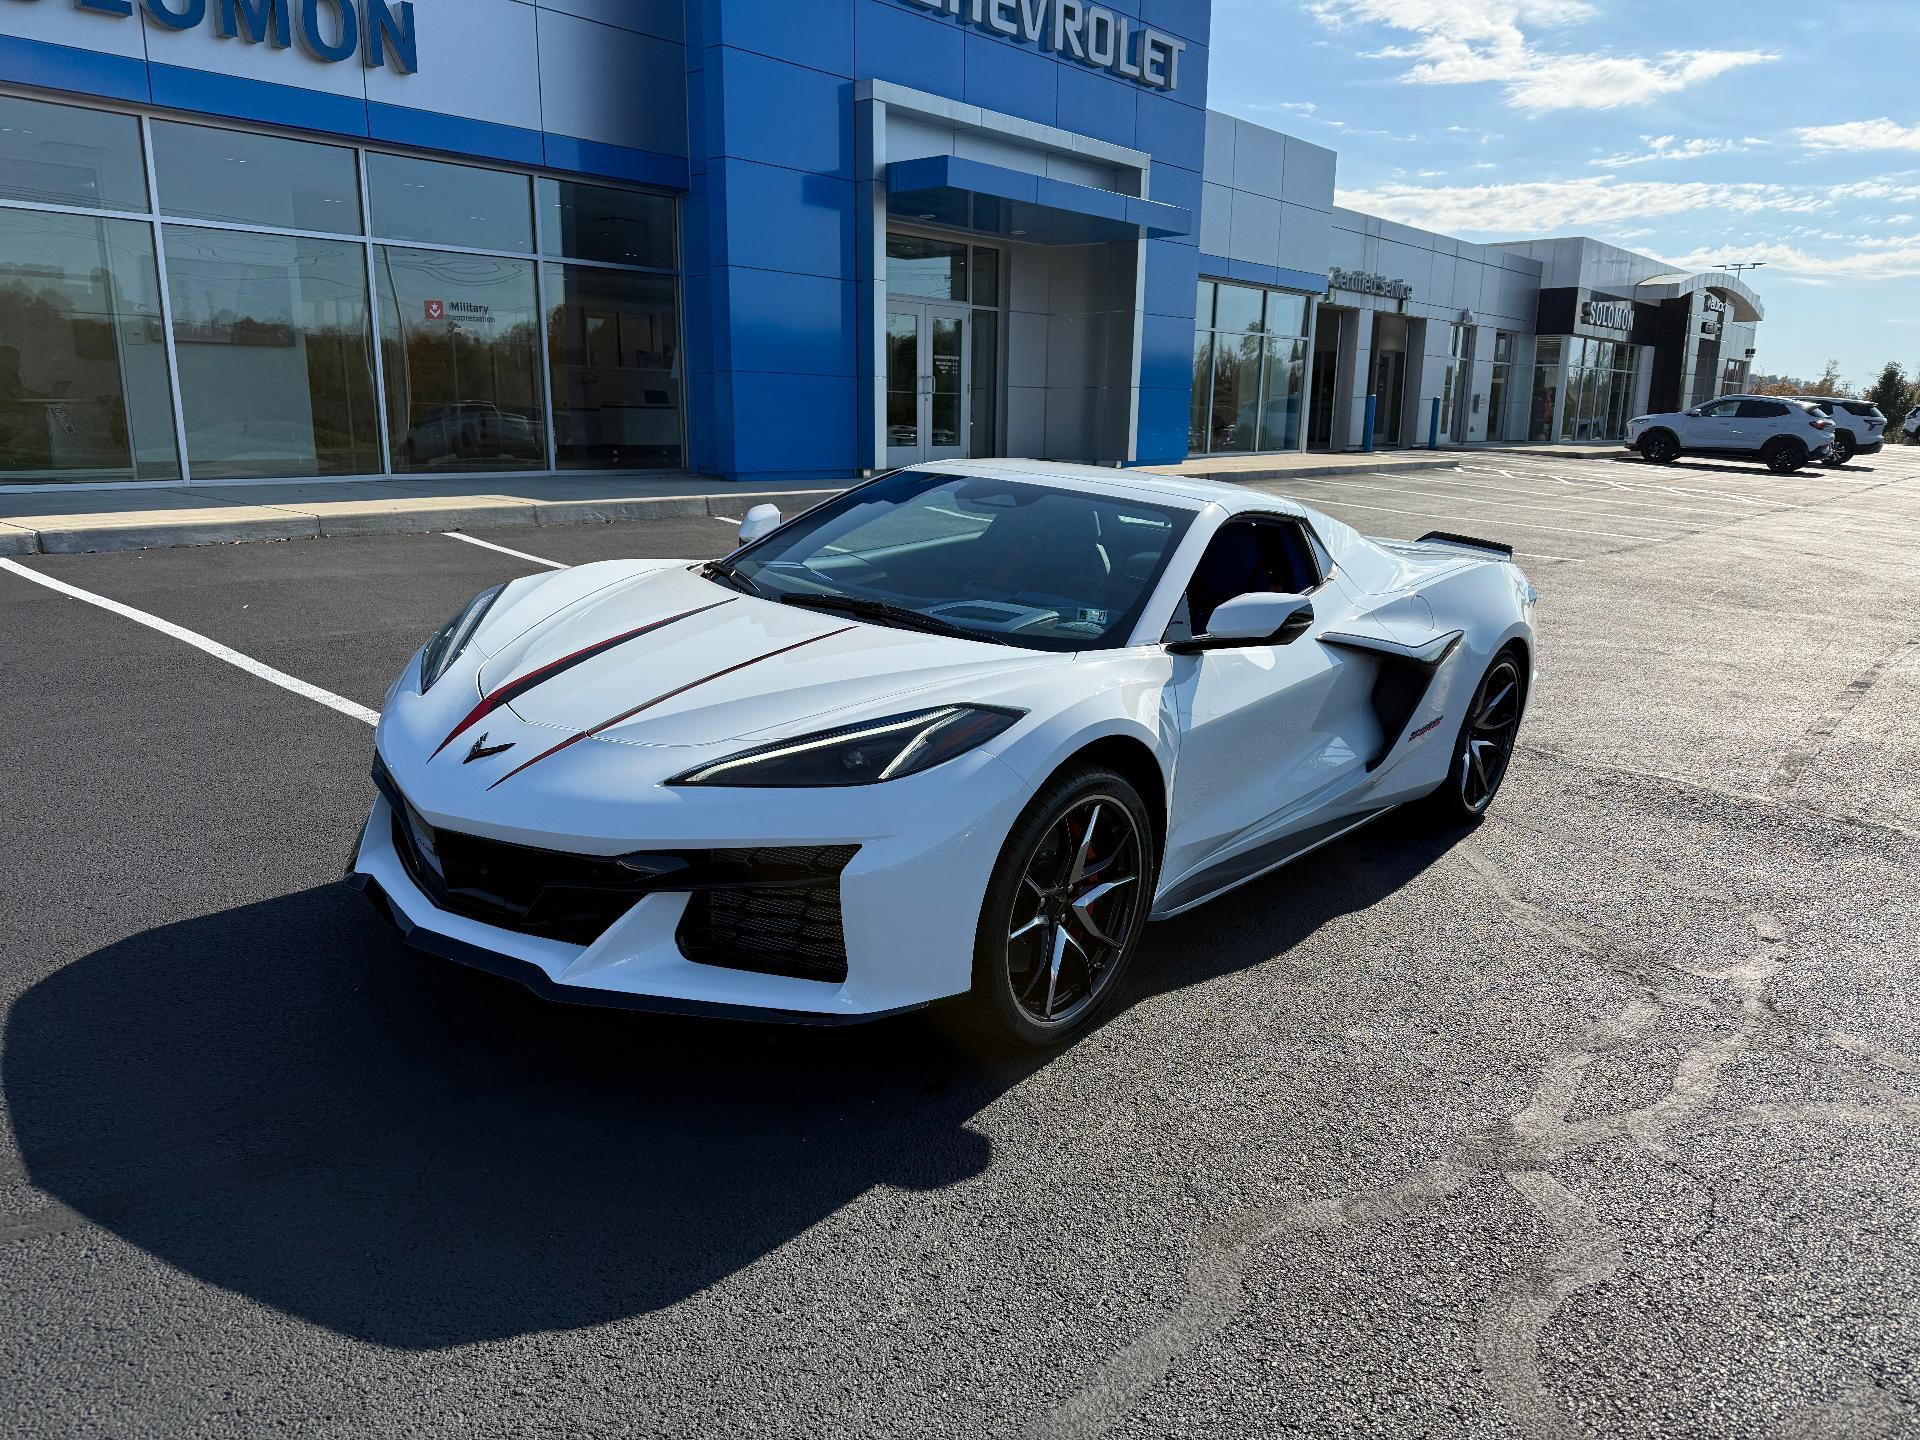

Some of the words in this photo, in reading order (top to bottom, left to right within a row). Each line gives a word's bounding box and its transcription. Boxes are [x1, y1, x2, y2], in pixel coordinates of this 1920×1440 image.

[1330, 269, 1377, 292] Certified
[1380, 279, 1413, 299] Service
[450, 301, 489, 315] Military
[1590, 301, 1635, 331] SOLOMON
